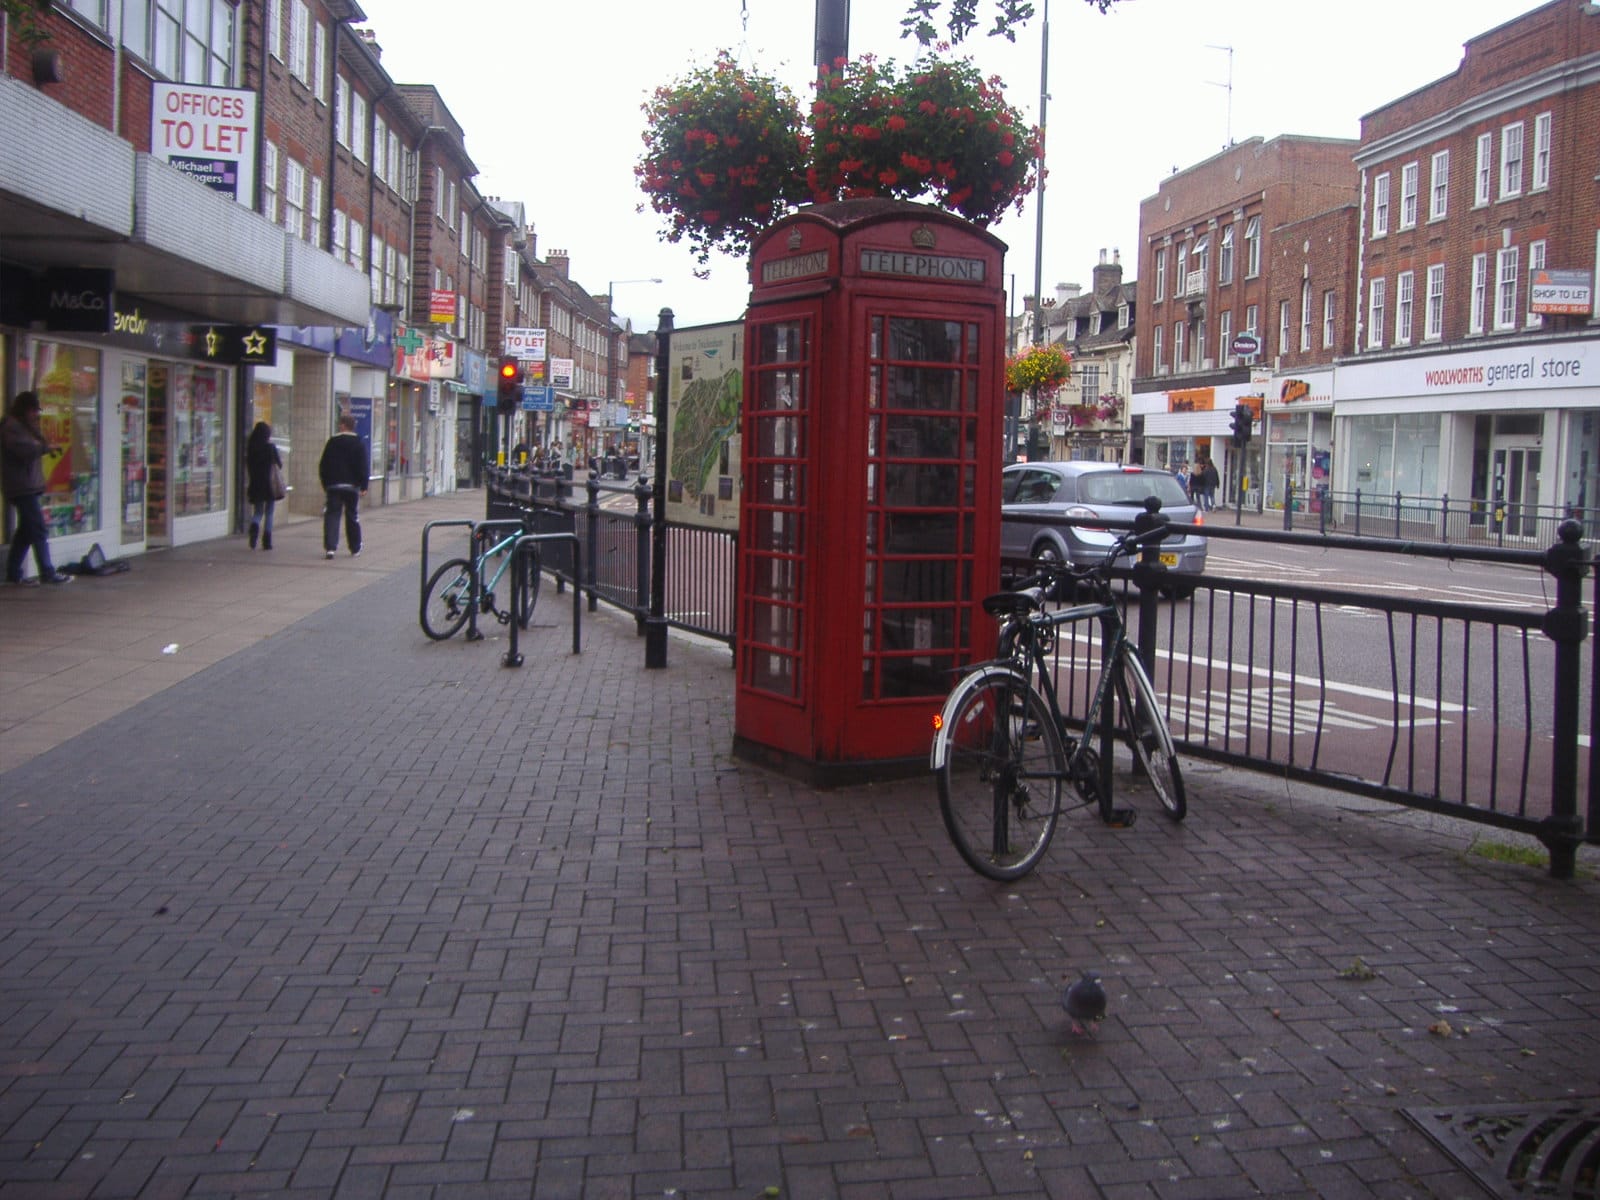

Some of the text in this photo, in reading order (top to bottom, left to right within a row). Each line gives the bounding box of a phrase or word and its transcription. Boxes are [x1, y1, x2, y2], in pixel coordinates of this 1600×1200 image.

[166, 91, 244, 119] OFFICES
[160, 119, 249, 154] TO LET
[171, 160, 213, 172] Michael
[766, 250, 827, 281] TELEPHONE
[863, 251, 979, 281] TELEPHONE
[50, 290, 104, 310] M&Co
[1533, 289, 1588, 299] SHOP TO LET
[507, 336, 545, 348] TO LET
[1425, 357, 1581, 387] WOOLWORTHS general store
